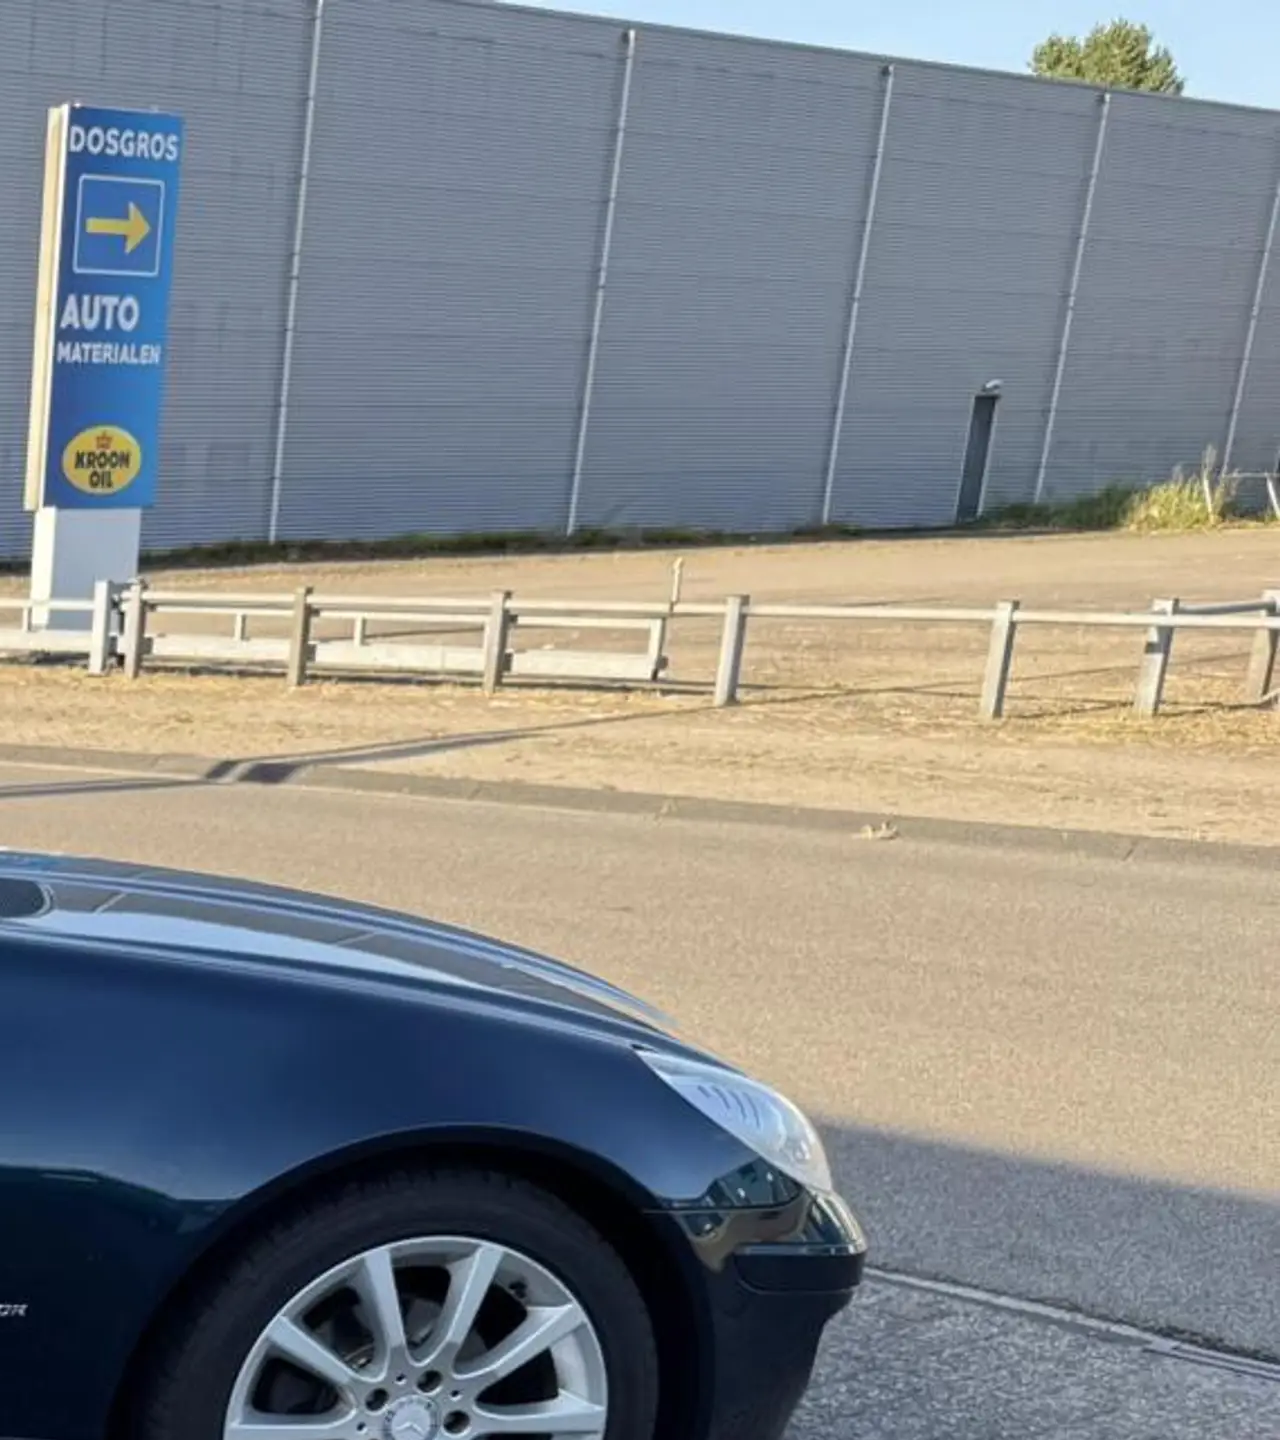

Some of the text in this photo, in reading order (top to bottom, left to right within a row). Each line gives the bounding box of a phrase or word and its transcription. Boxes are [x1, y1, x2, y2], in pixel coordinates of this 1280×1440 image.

[69, 125, 179, 162] DOSGROS
[60, 294, 140, 331] AUTO
[56, 341, 161, 365] MATERIALEN
[74, 450, 131, 469] KROON
[88, 470, 114, 488] OIL
